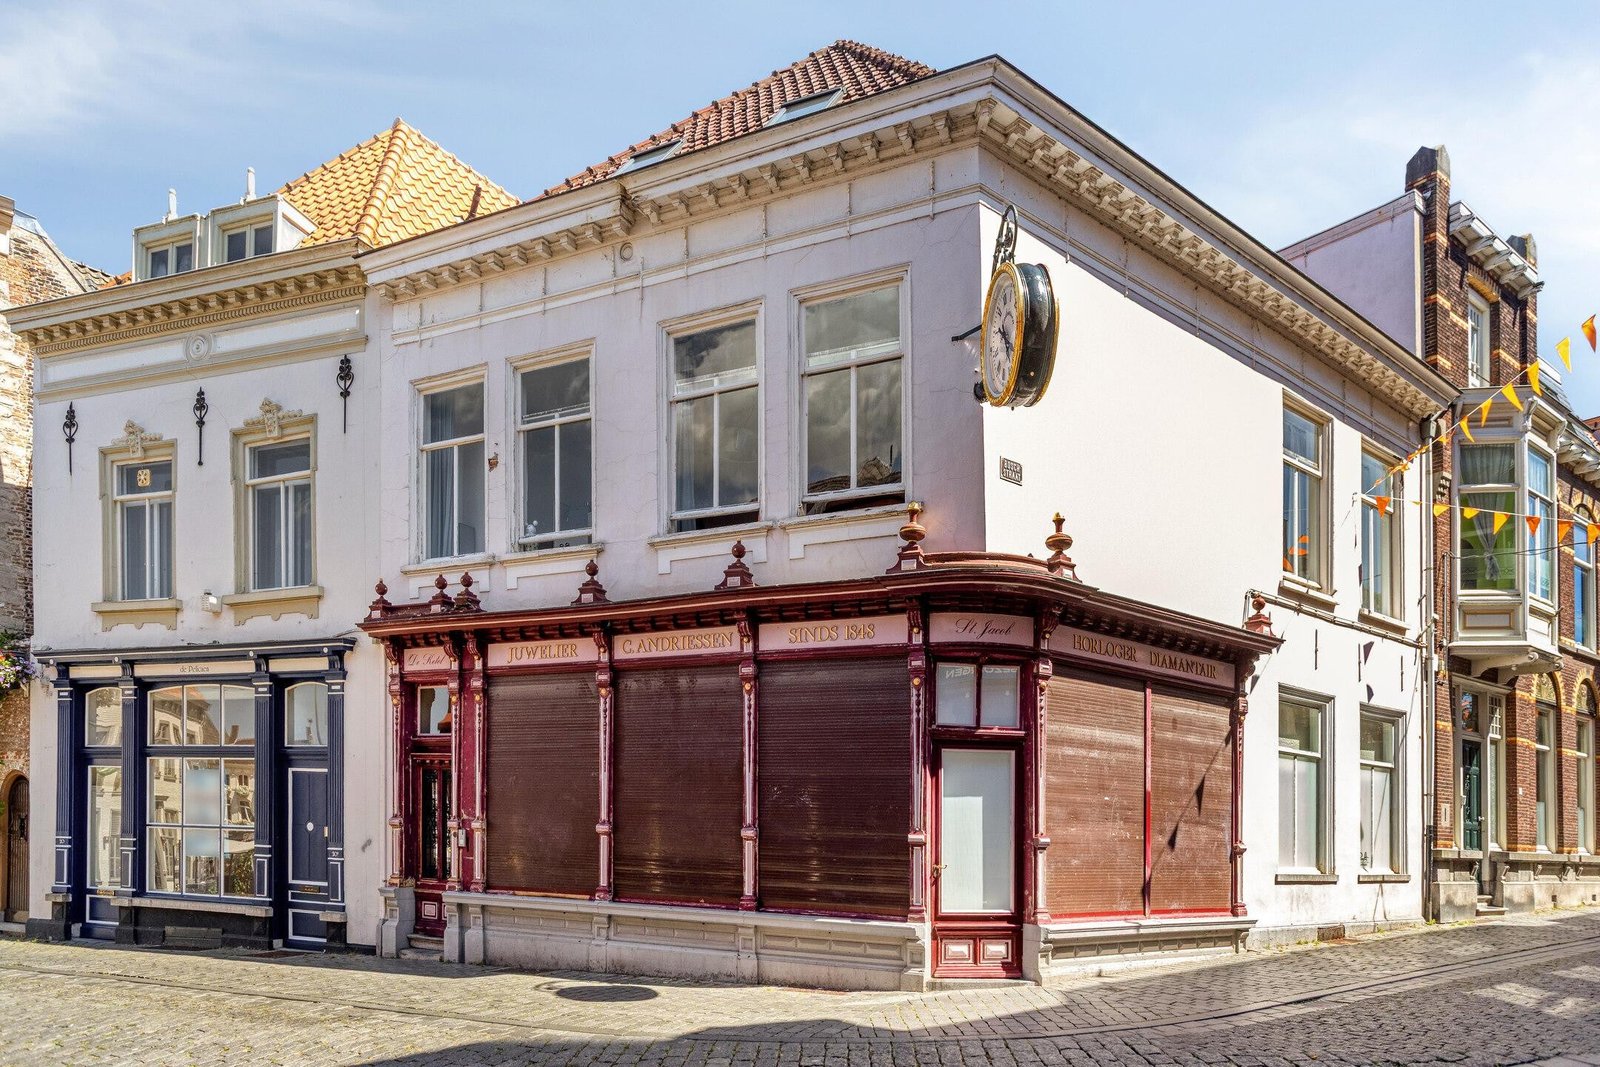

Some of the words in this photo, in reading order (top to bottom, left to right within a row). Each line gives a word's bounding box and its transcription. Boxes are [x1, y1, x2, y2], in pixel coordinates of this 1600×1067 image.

[788, 625, 839, 644] SINDS
[844, 623, 875, 641] 1848
[976, 620, 1016, 640] Jacob
[637, 631, 734, 653] ANDRIESSEN
[507, 643, 579, 664] JUWELIER
[1072, 634, 1138, 662] HORLOGER
[1150, 651, 1217, 679] DIAMANTAIR
